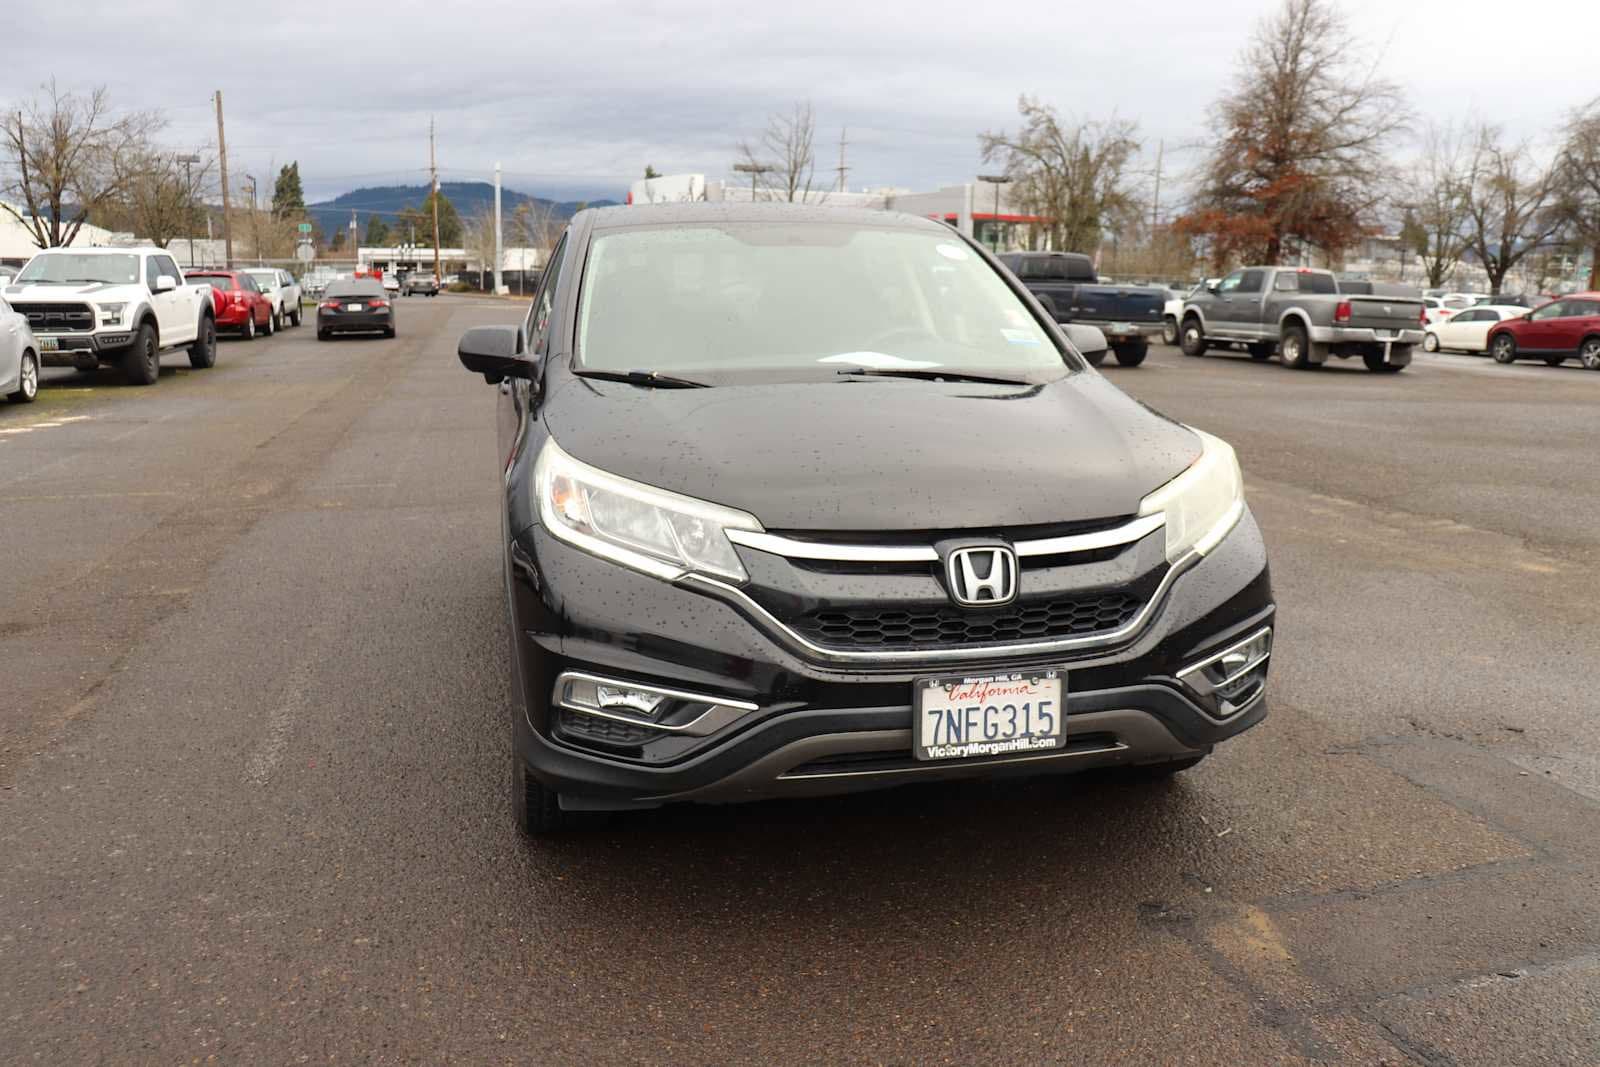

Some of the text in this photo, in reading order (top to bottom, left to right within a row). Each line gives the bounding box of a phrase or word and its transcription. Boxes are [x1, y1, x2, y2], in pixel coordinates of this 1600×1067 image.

[25, 312, 92, 320] ORD
[1010, 672, 1022, 681] CA
[949, 682, 1037, 704] California
[928, 701, 1054, 745] 7NFG315
